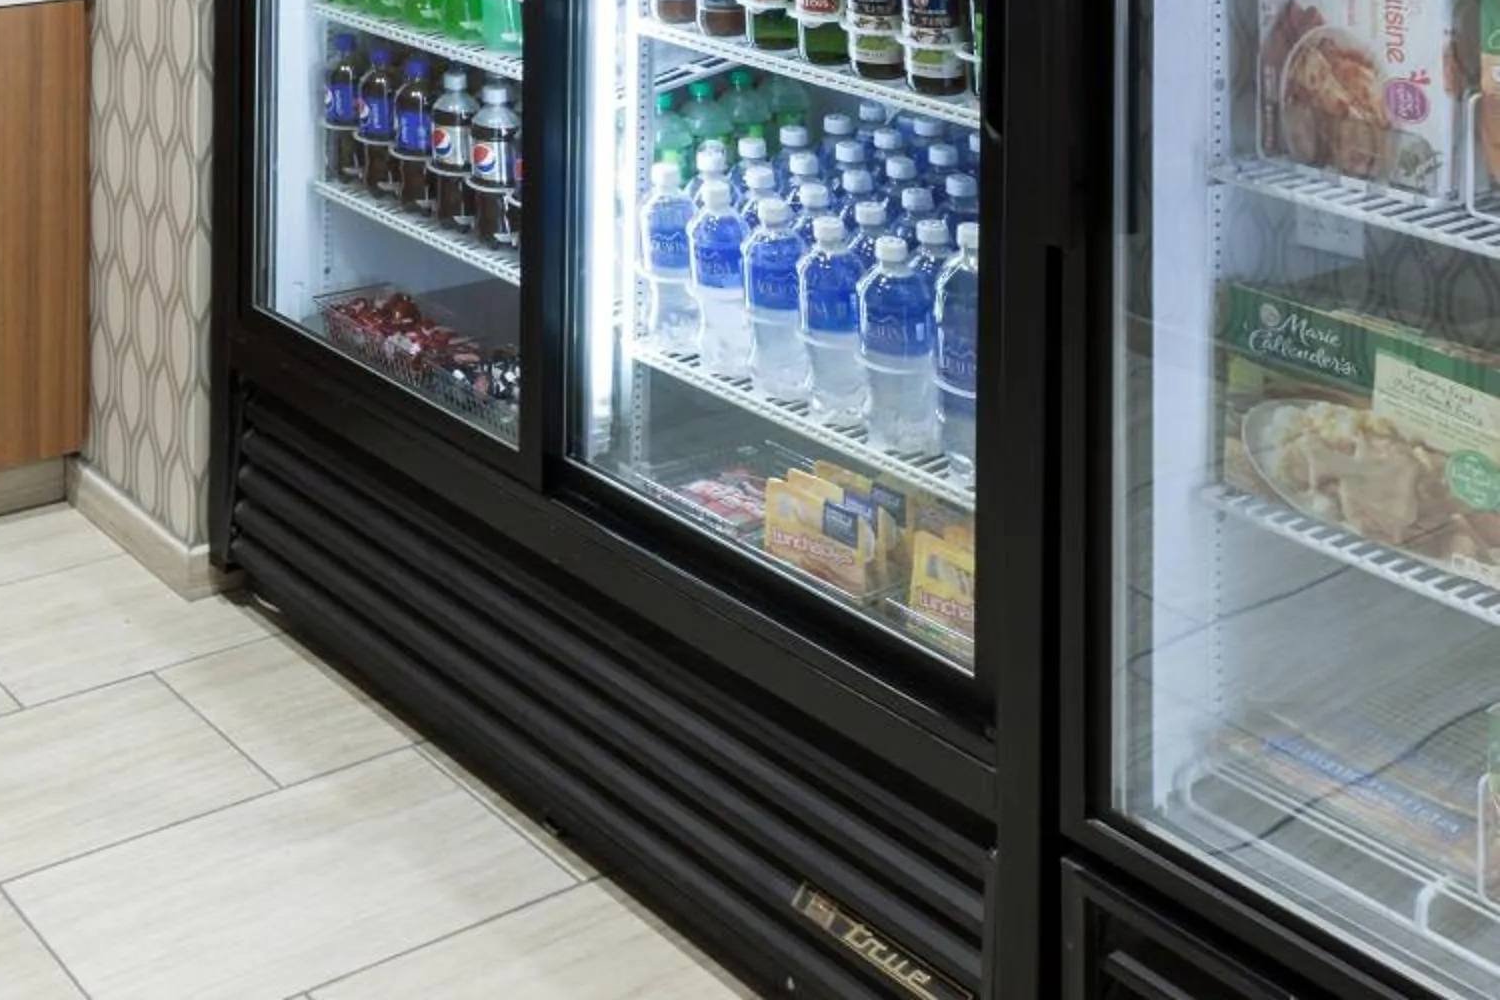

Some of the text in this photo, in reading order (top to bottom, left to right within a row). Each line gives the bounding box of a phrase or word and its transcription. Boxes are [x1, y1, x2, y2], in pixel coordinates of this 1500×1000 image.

[1275, 313, 1342, 347] Marie
[1250, 329, 1358, 377] Callender's
[921, 590, 975, 619] Luncha
